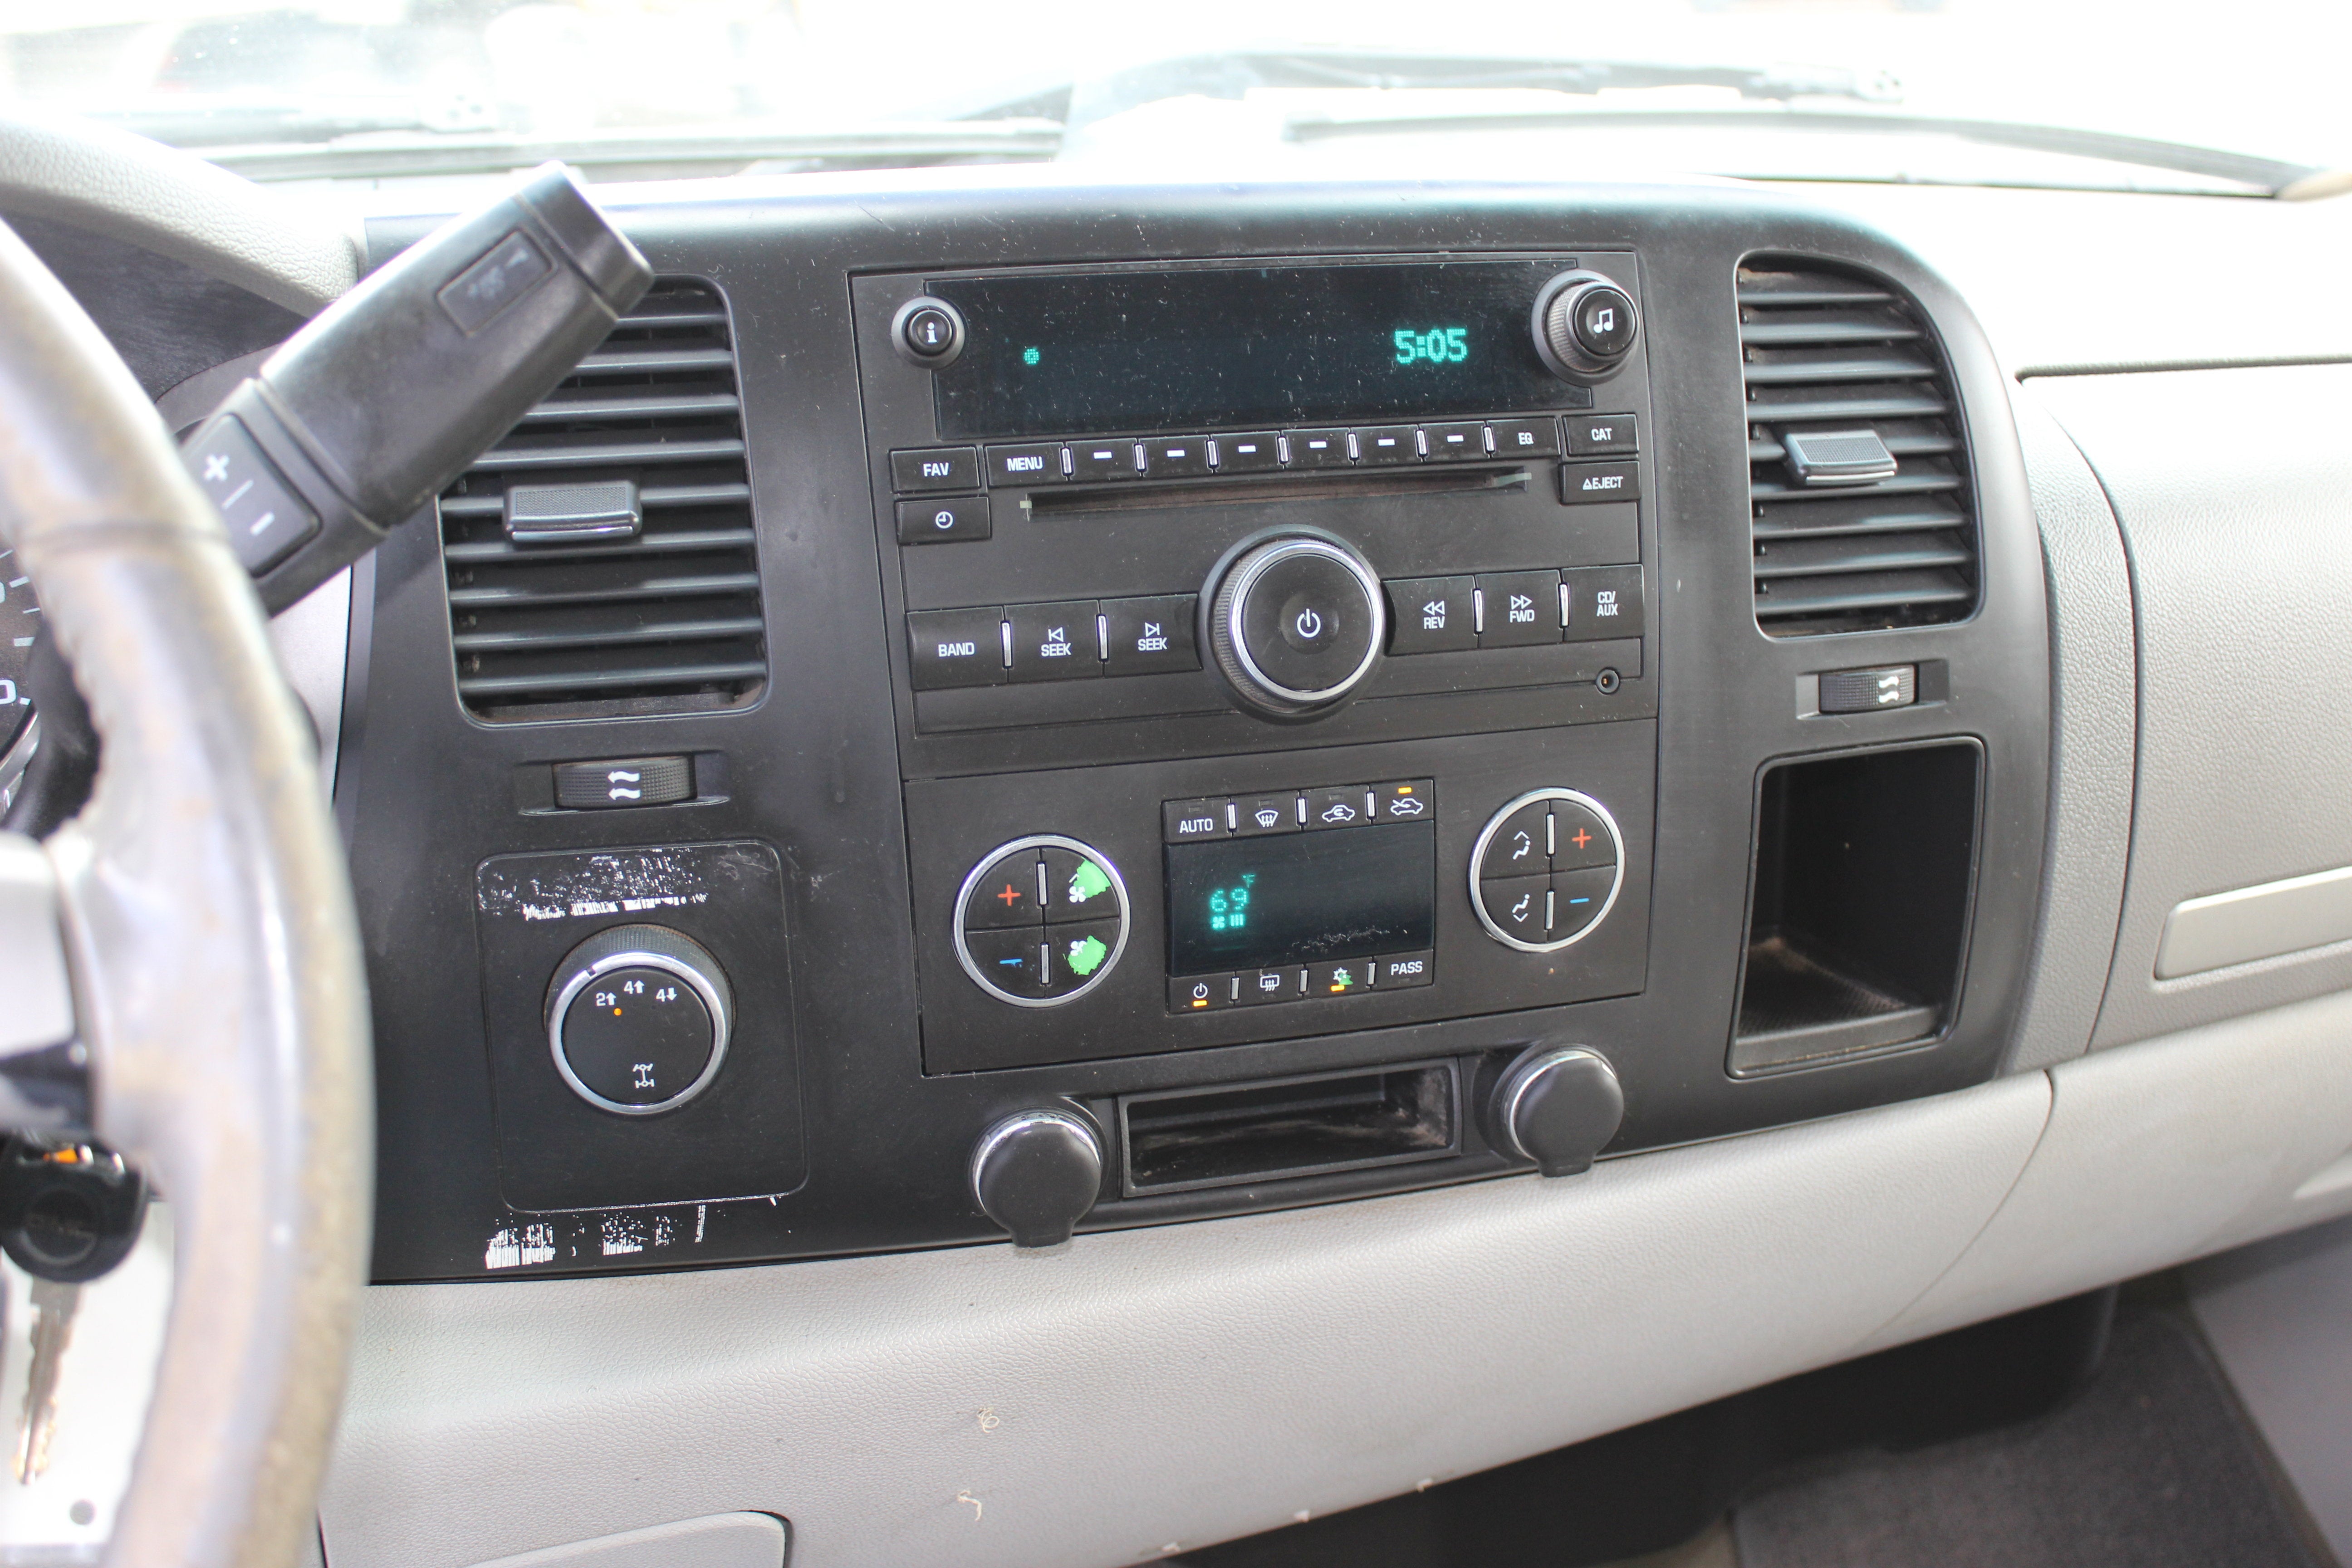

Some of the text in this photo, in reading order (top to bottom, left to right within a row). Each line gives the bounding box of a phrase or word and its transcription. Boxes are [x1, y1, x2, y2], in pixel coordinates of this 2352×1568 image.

[1394, 328, 1468, 363] 5:05
[1518, 431, 1534, 446] EQ
[1591, 427, 1612, 441] CAT
[923, 462, 950, 477] FAV
[1006, 456, 1044, 472] MENU
[1592, 476, 1624, 490] EJECT
[1509, 609, 1535, 623] FWD
[1597, 603, 1618, 617] AUX
[1423, 616, 1446, 630] REV
[938, 642, 975, 657] BAND
[1040, 642, 1072, 657] SEEK
[1137, 637, 1168, 652] SEEK
[1179, 818, 1214, 834] AUTO
[1211, 888, 1247, 911] 69
[1390, 960, 1423, 975] PASS
